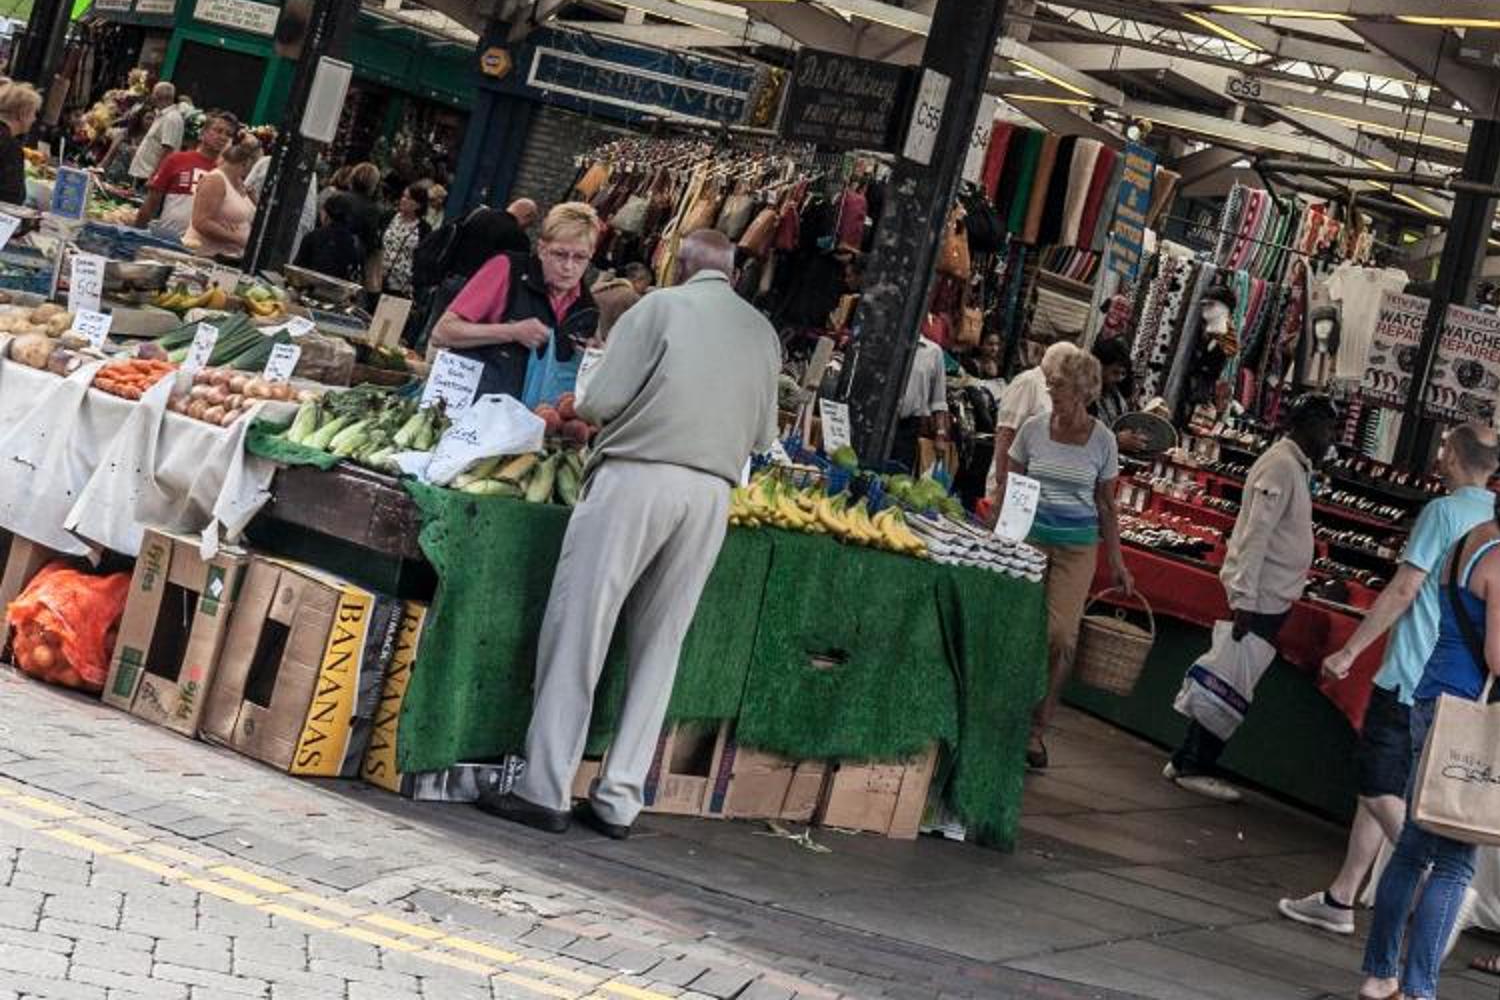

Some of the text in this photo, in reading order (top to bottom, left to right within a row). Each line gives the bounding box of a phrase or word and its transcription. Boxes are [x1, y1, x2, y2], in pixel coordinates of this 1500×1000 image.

[1230, 79, 1261, 97] C53
[918, 102, 941, 132] C55
[971, 125, 991, 149] 54
[1379, 310, 1426, 330] WATC
[297, 603, 365, 769] BANANAS
[366, 610, 419, 779] BANANAS
